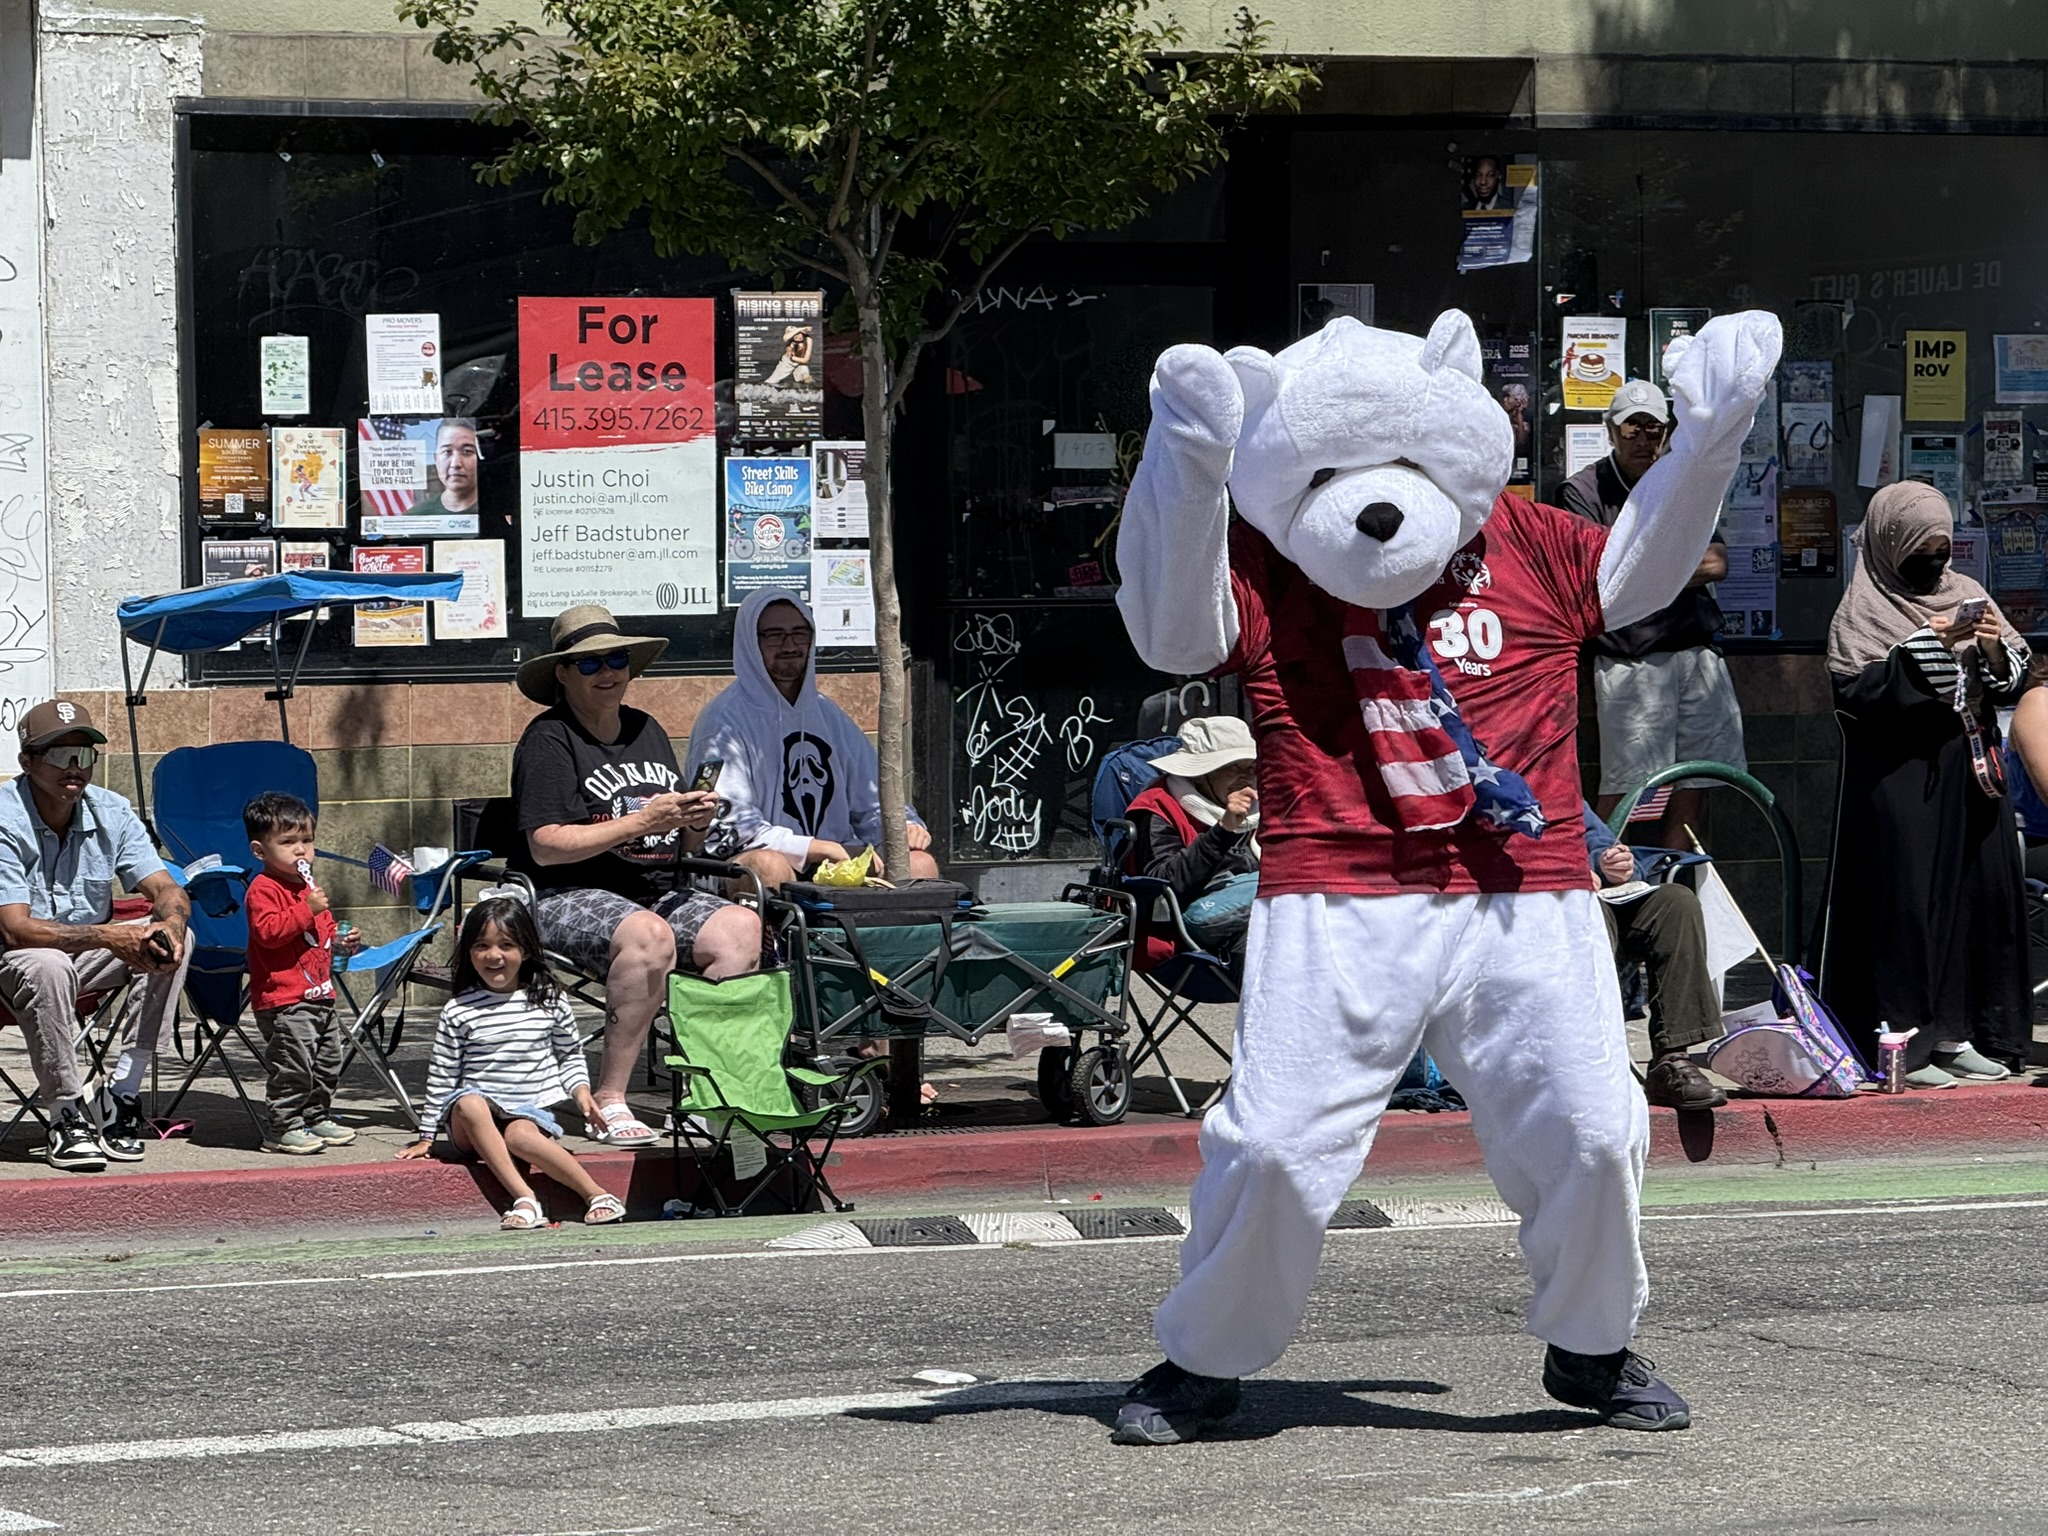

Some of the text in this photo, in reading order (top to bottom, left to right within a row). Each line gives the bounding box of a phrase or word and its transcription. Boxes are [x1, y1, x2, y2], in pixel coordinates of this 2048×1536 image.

[738, 300, 818, 311] RISING SEAS
[578, 306, 658, 344] For
[1482, 349, 1502, 359] ERA
[1509, 344, 1529, 353] 2025
[1914, 340, 1956, 358] IMP
[550, 354, 687, 391] Lease
[1913, 364, 1950, 377] ROV
[533, 407, 704, 430] 415.395.7262
[208, 438, 260, 449] SUMMER
[374, 468, 413, 476] TO PUT YOUR
[531, 469, 649, 488] Justin Choi
[742, 465, 799, 480] Street Skills
[744, 481, 793, 498] Bike Camp
[533, 493, 668, 506] justin.choi@am.jll.com
[1787, 498, 1831, 508] SUMMER
[533, 508, 543, 516] RE
[531, 524, 690, 542] Jeff Badstubner
[532, 549, 698, 562] jeff.badstubner@am.jll.com
[551, 590, 570, 598] Lang
[680, 587, 712, 604] JLL
[1429, 608, 1503, 660] 30
[1454, 658, 1492, 677] Years
[584, 761, 679, 801] OLD NAVY
